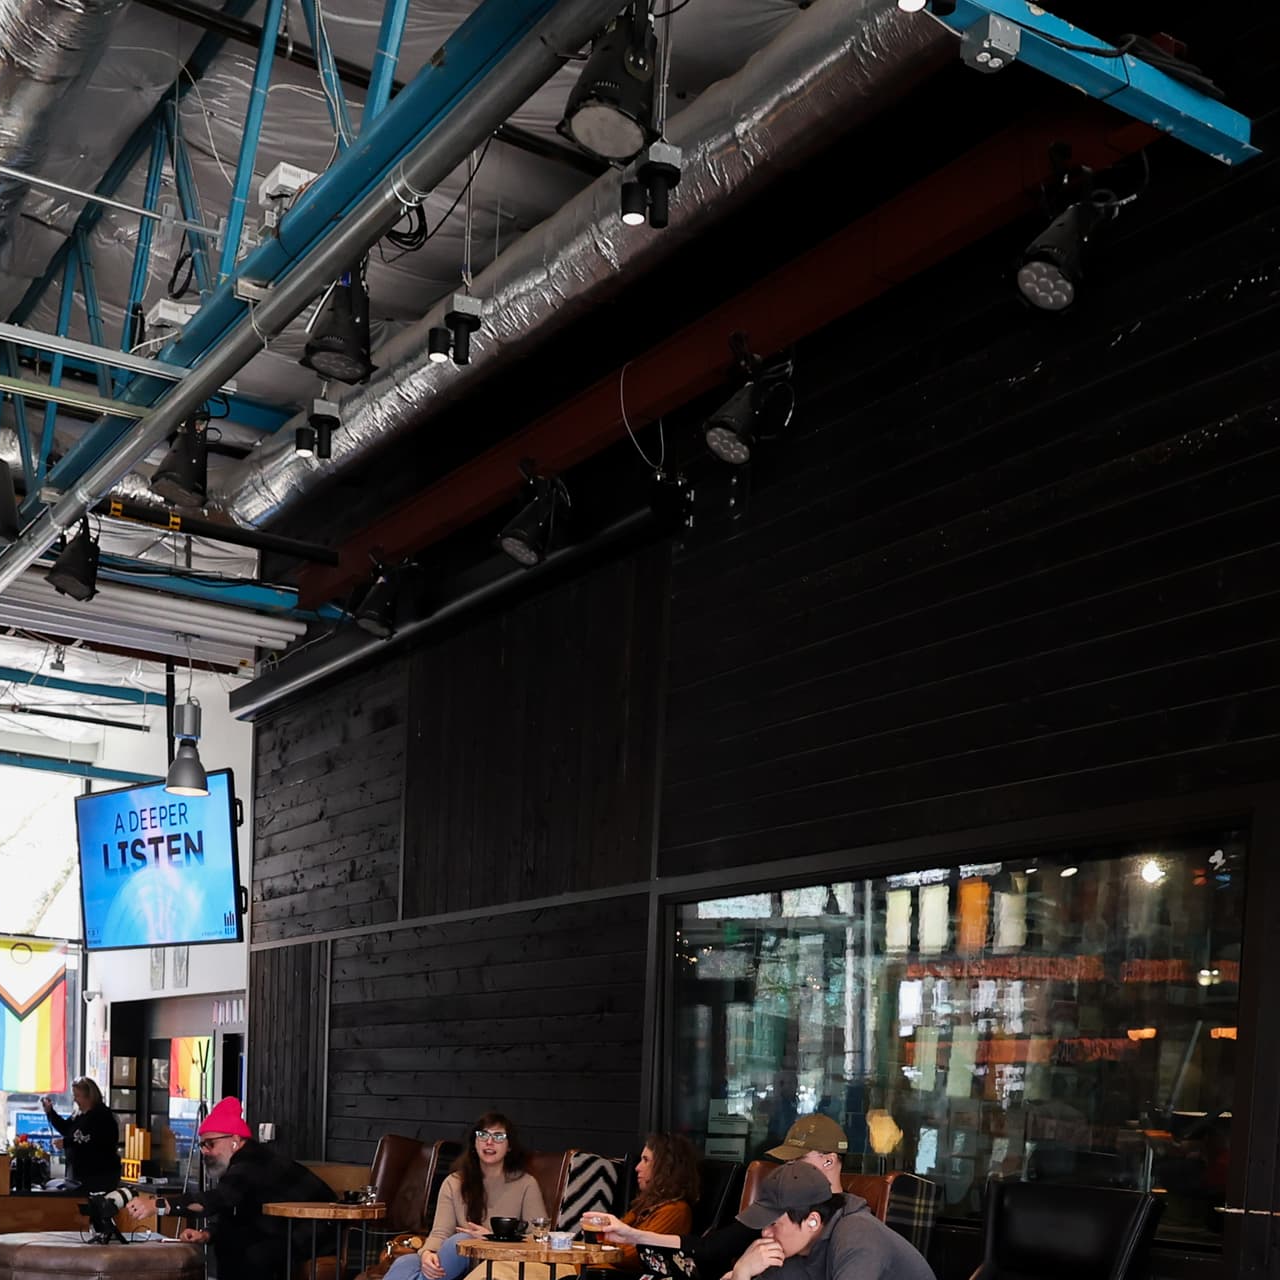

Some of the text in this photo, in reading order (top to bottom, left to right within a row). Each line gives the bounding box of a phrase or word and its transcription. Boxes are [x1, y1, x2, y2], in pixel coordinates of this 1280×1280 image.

[114, 802, 189, 835] A DEEPER
[102, 830, 205, 876] LISTEN
